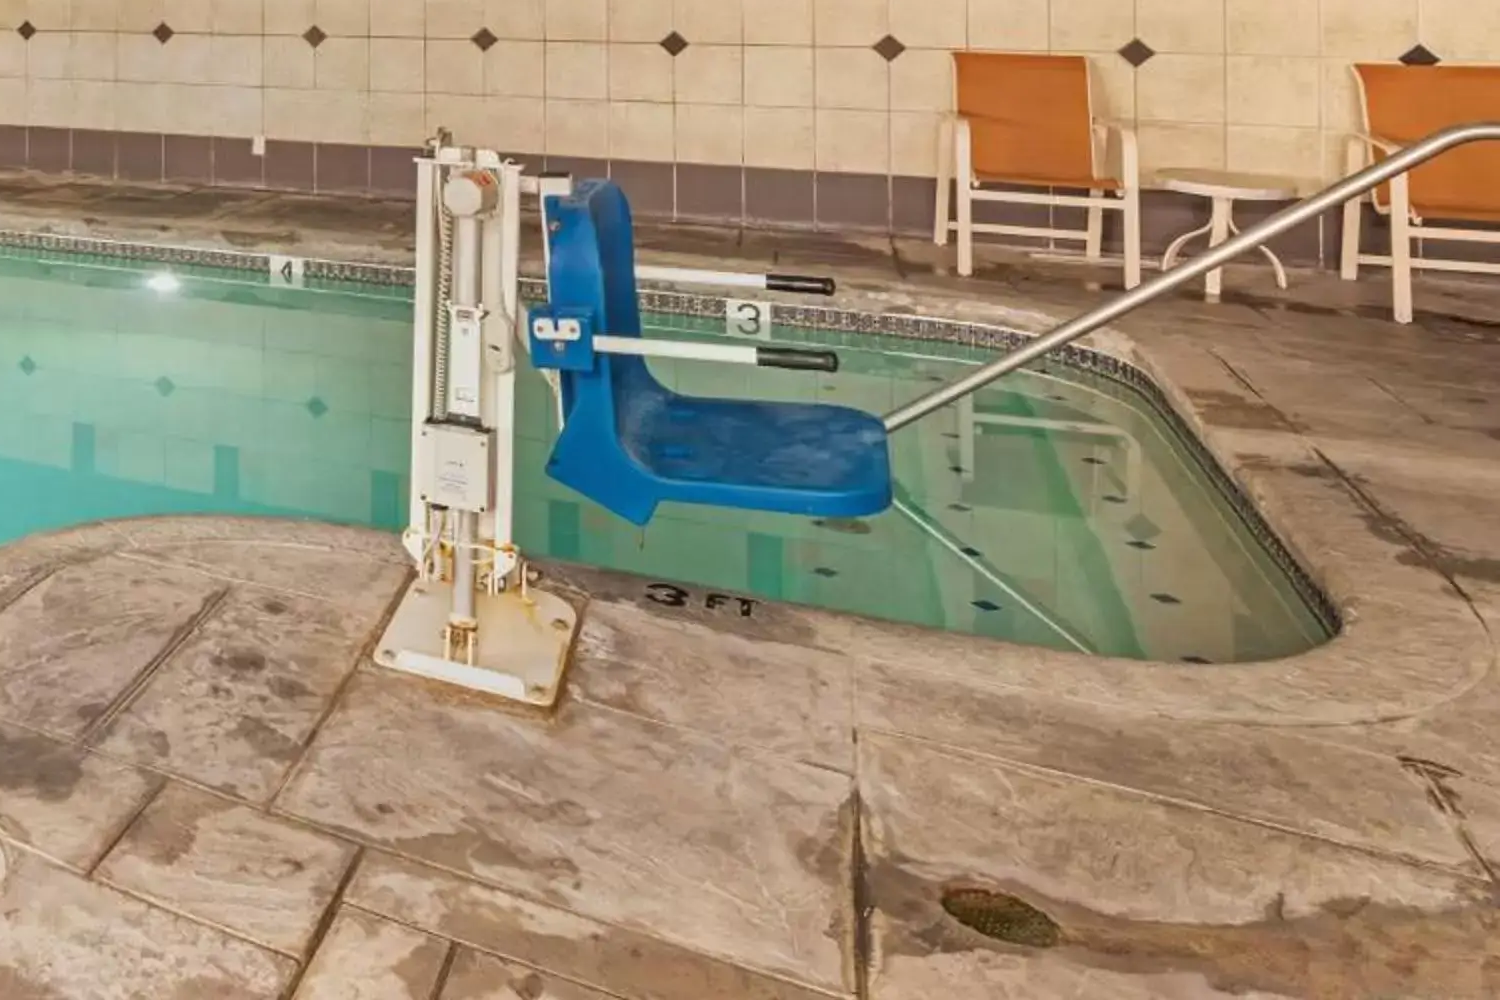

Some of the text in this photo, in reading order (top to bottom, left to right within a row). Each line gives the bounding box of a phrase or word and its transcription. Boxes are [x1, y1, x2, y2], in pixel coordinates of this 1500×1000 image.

[736, 303, 760, 335] 3
[645, 583, 759, 617] 3 FT
